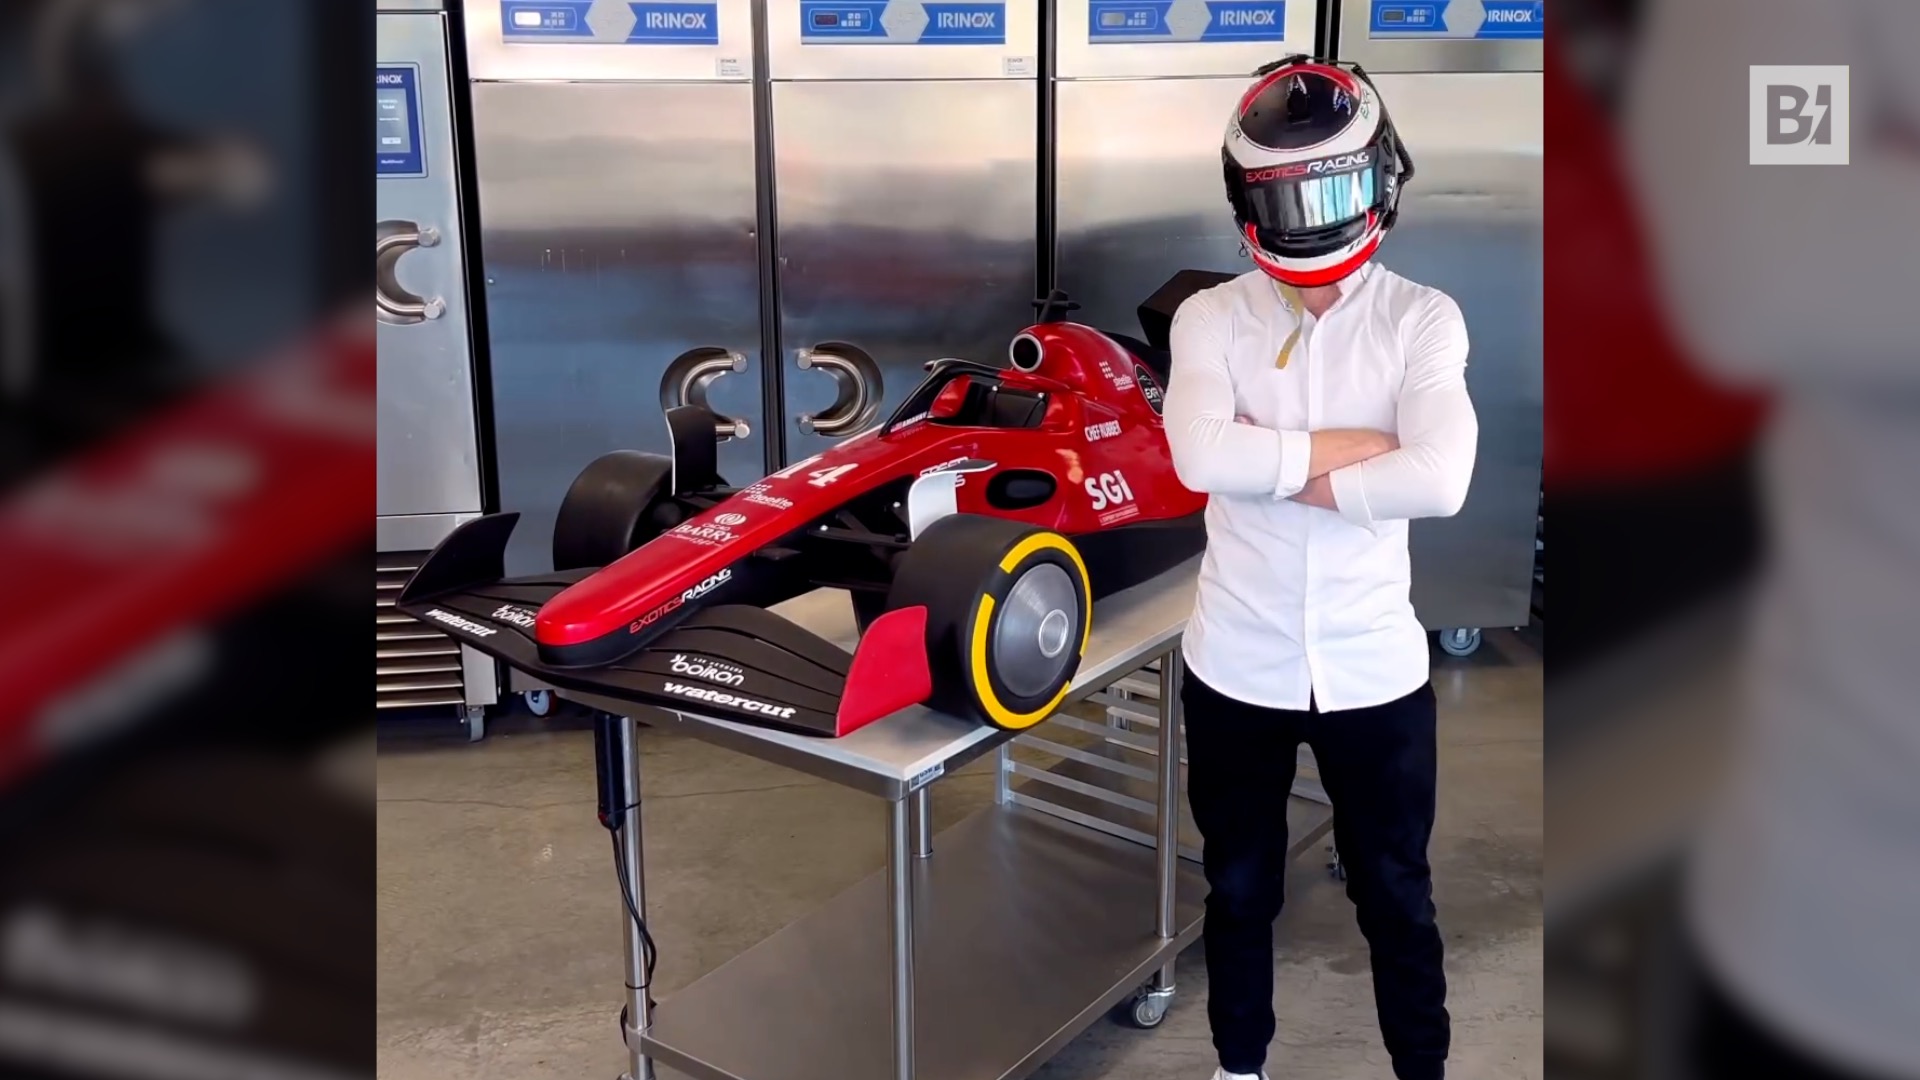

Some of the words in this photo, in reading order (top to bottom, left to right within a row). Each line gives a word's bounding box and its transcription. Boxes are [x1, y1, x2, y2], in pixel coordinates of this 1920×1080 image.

[646, 12, 707, 29] IRINOX
[937, 12, 996, 29] IRINOX
[1219, 9, 1276, 26] IRINOX
[1487, 9, 1533, 23] IRINOX
[376, 74, 403, 84] INOX
[771, 454, 859, 488] 14
[1084, 469, 1135, 511] SGI
[674, 524, 740, 542] BARRY
[425, 608, 498, 637] watercut
[663, 682, 797, 719] watercut
